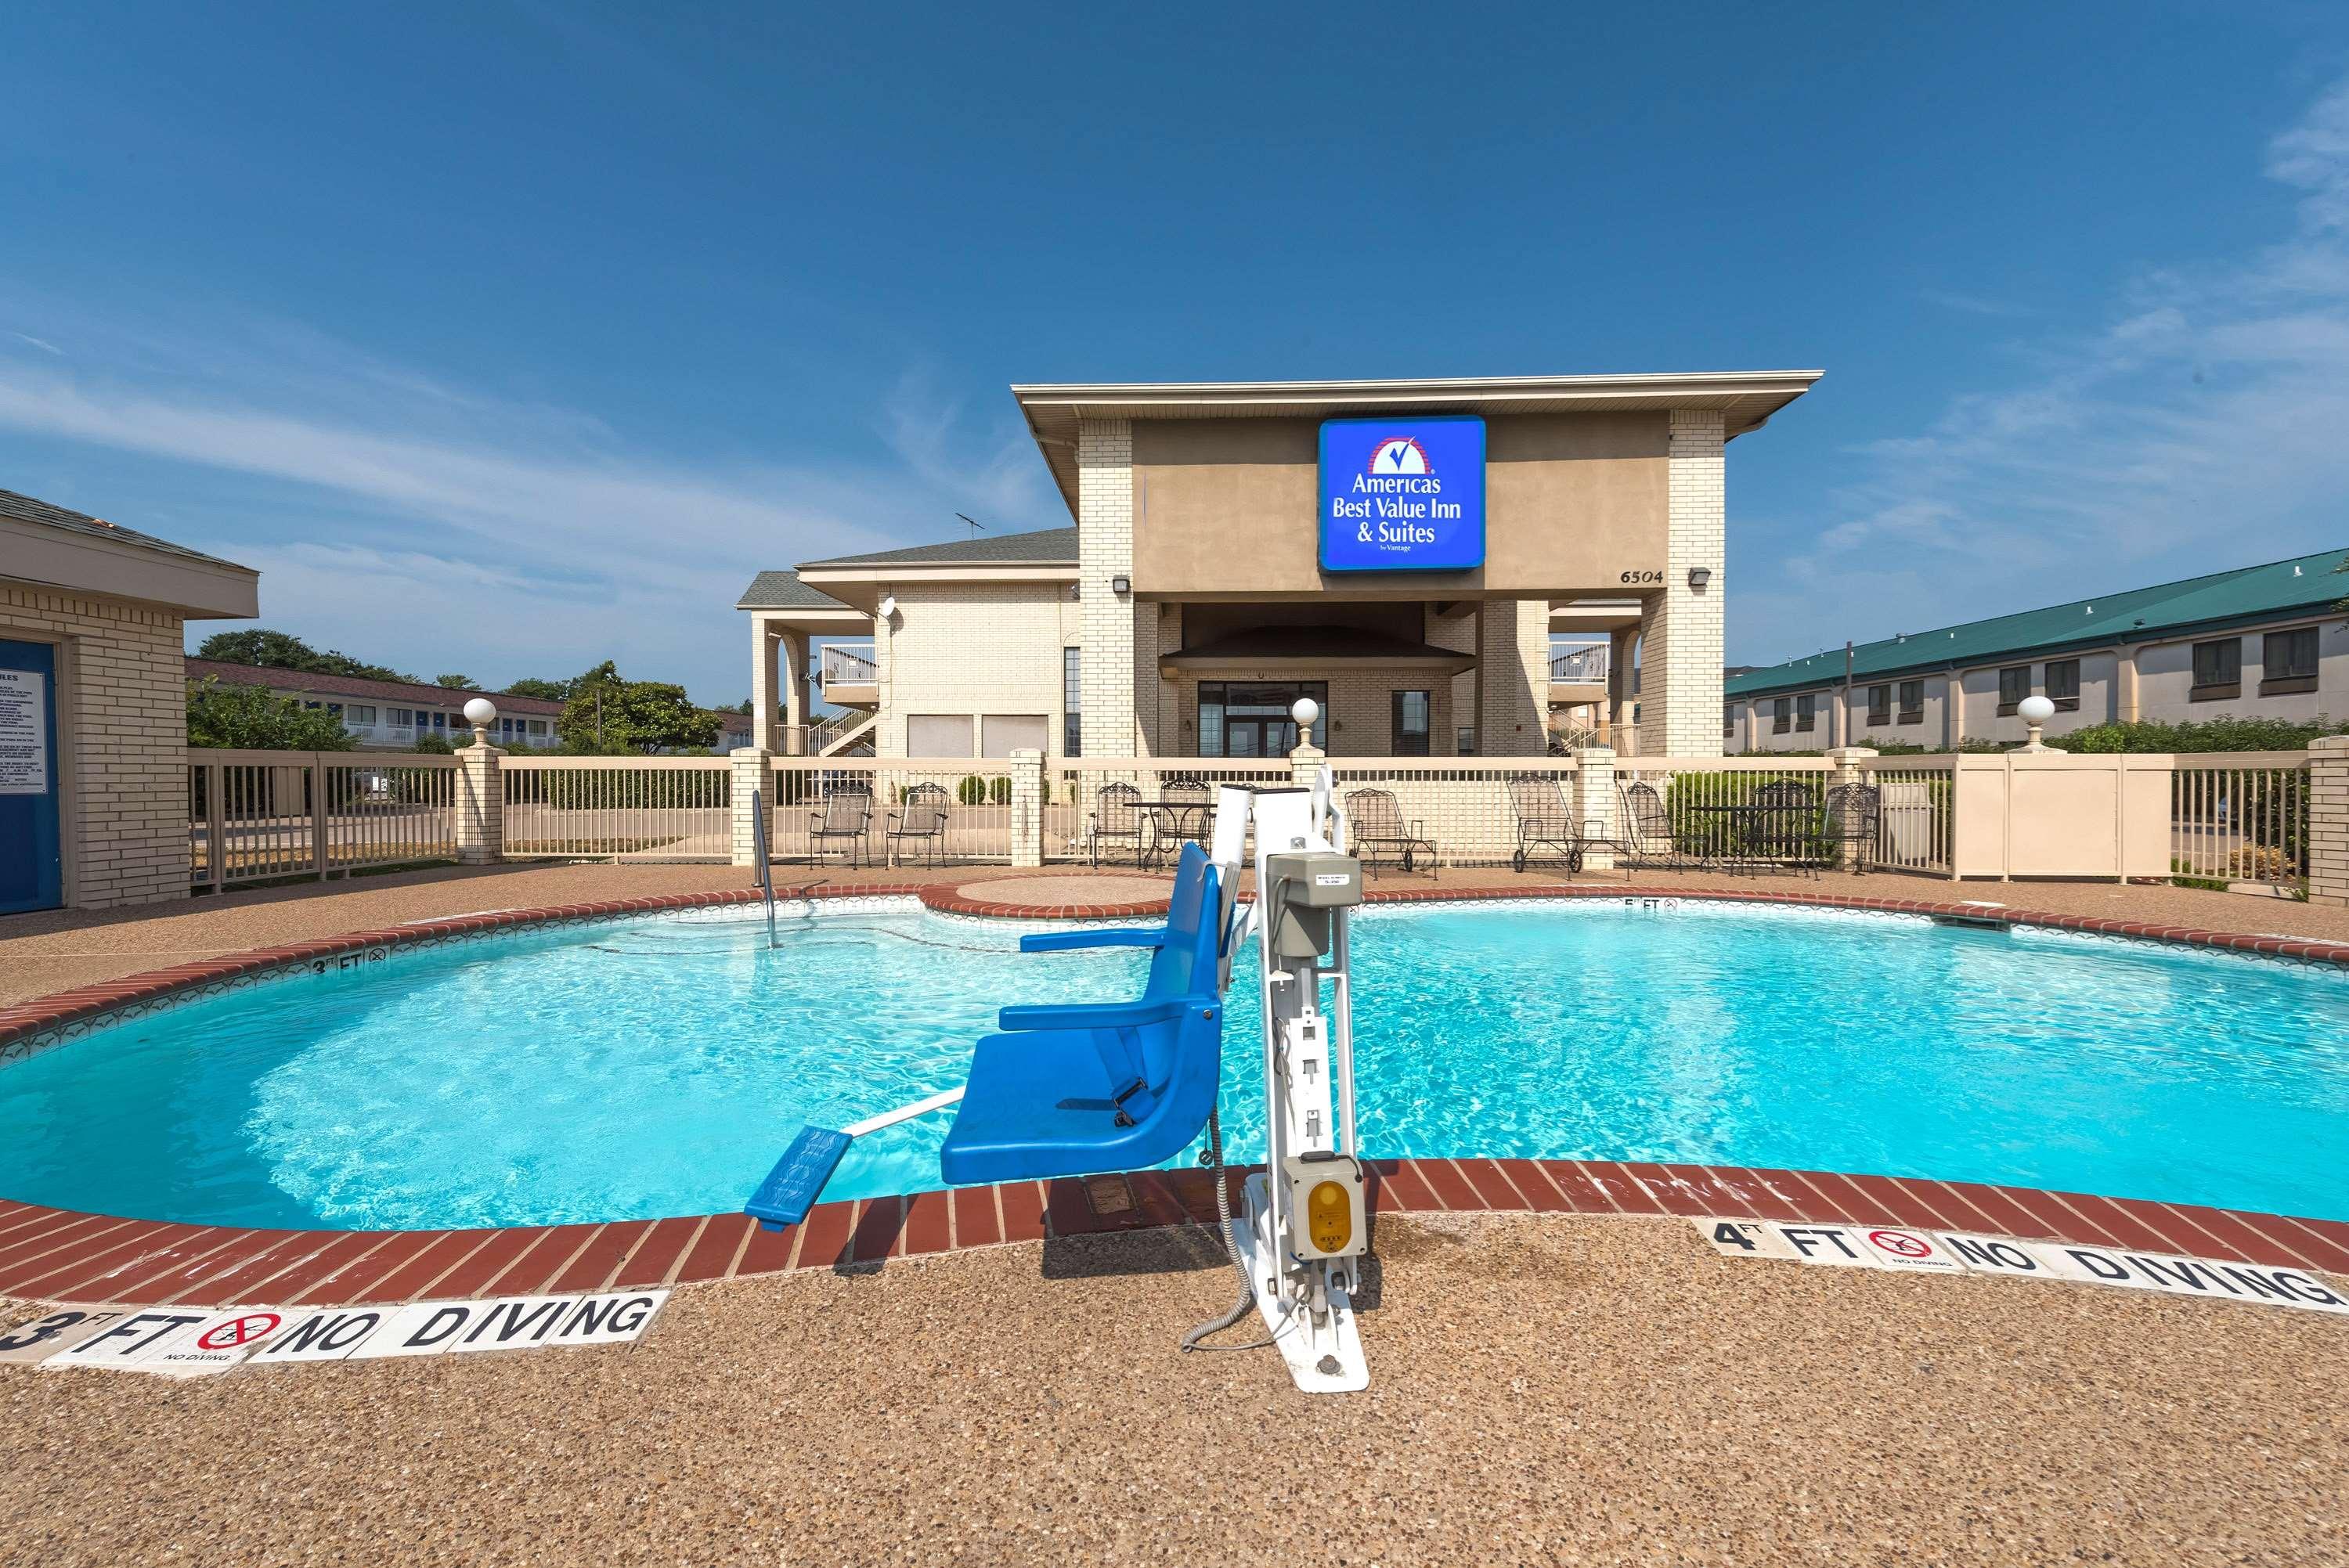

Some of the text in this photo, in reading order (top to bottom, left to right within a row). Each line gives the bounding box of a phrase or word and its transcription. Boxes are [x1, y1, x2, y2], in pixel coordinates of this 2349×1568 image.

[1352, 473, 1441, 494] Americas
[1333, 496, 1461, 518] Best Value Inn
[1357, 521, 1435, 542] & Suites
[1621, 571, 1663, 583] 6504
[1644, 899, 1659, 909] FT
[340, 953, 361, 970] FT
[1779, 1228, 1859, 1259] FT
[1945, 1237, 2036, 1270] NO
[2065, 1249, 2348, 1306] DIVING
[70, 1314, 207, 1355] FT
[266, 1313, 381, 1354] NO
[402, 1297, 654, 1347] DIVING
